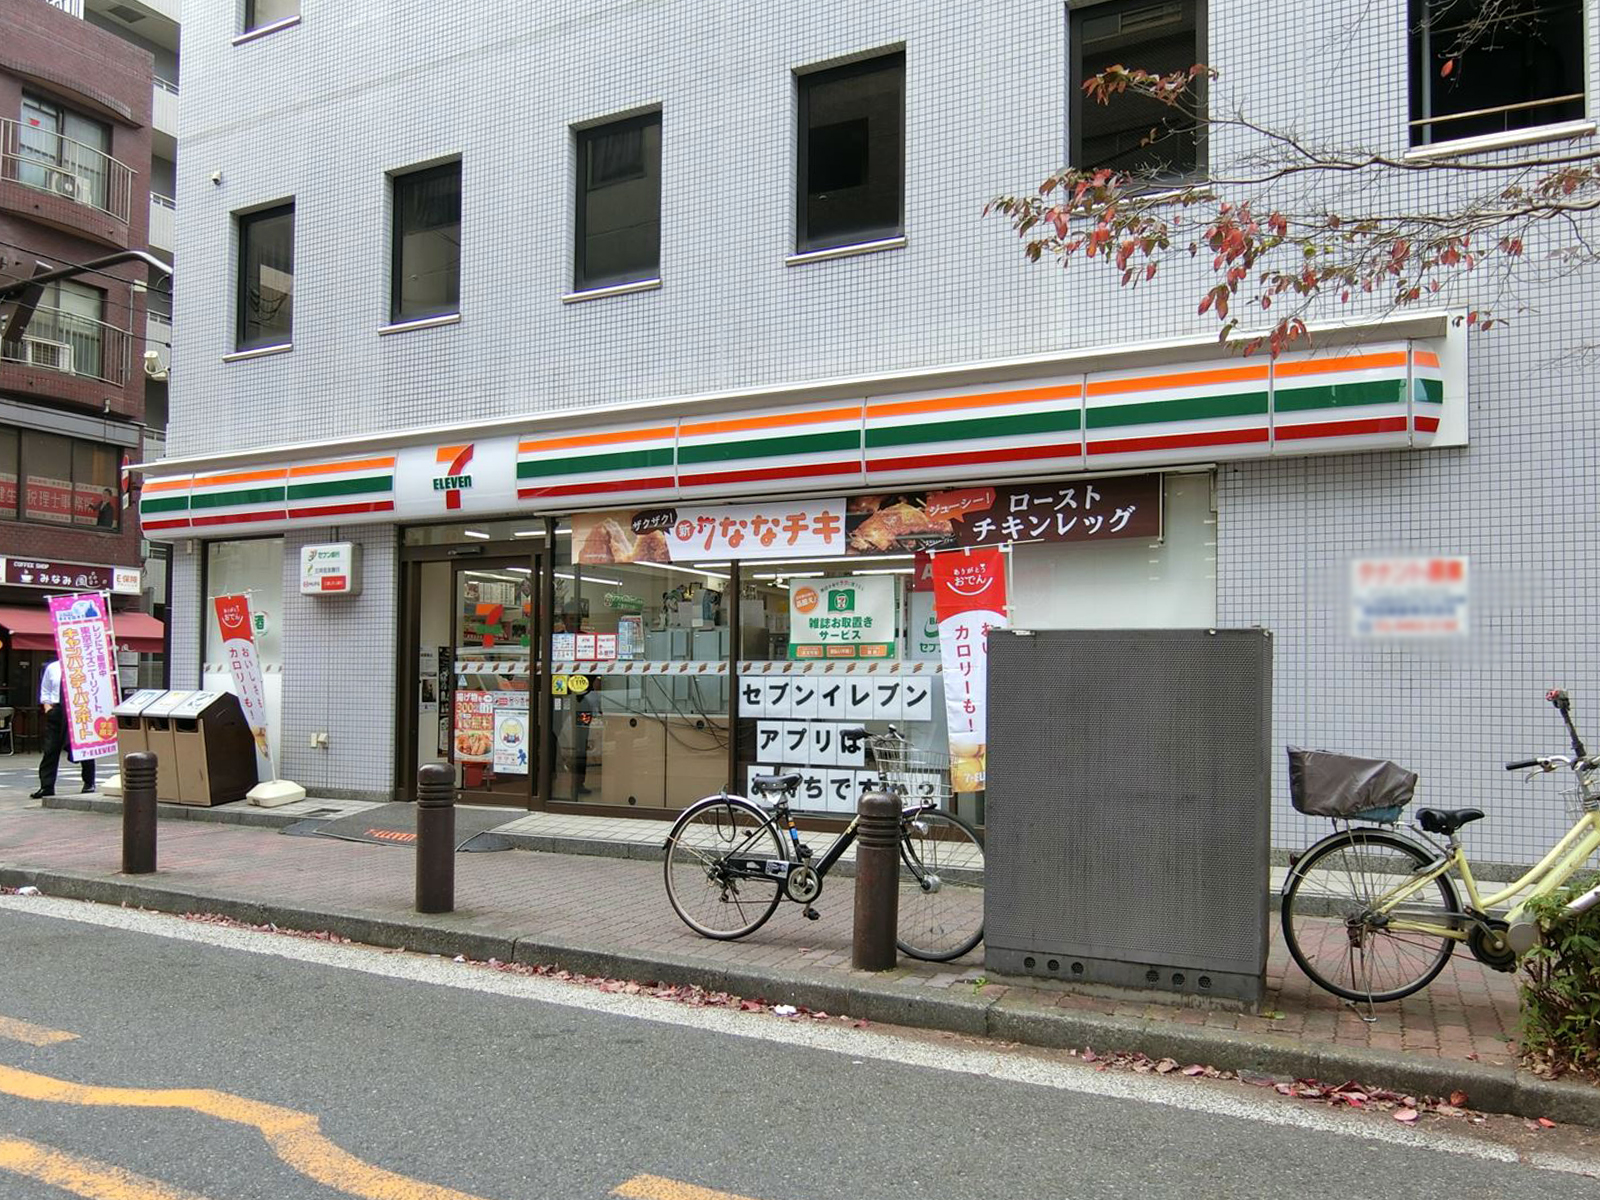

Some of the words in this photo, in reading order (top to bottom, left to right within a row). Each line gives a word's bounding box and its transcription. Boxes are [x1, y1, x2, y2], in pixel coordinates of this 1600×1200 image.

[928, 492, 991, 516] ジューシー!
[1009, 485, 1101, 513] ロースト
[632, 512, 674, 531] ザクザク!
[972, 505, 1136, 541] チキンレッグ
[13, 561, 35, 569] COFFEE
[953, 563, 986, 576] ありがとう
[39, 573, 72, 586] みなみ
[954, 575, 986, 587] おでん
[808, 617, 873, 629] 雑誌お取置き
[819, 630, 861, 640] サービス
[955, 625, 976, 732] カロリーも!
[742, 682, 928, 707] セブンイレブン
[760, 728, 862, 754] アプリは
